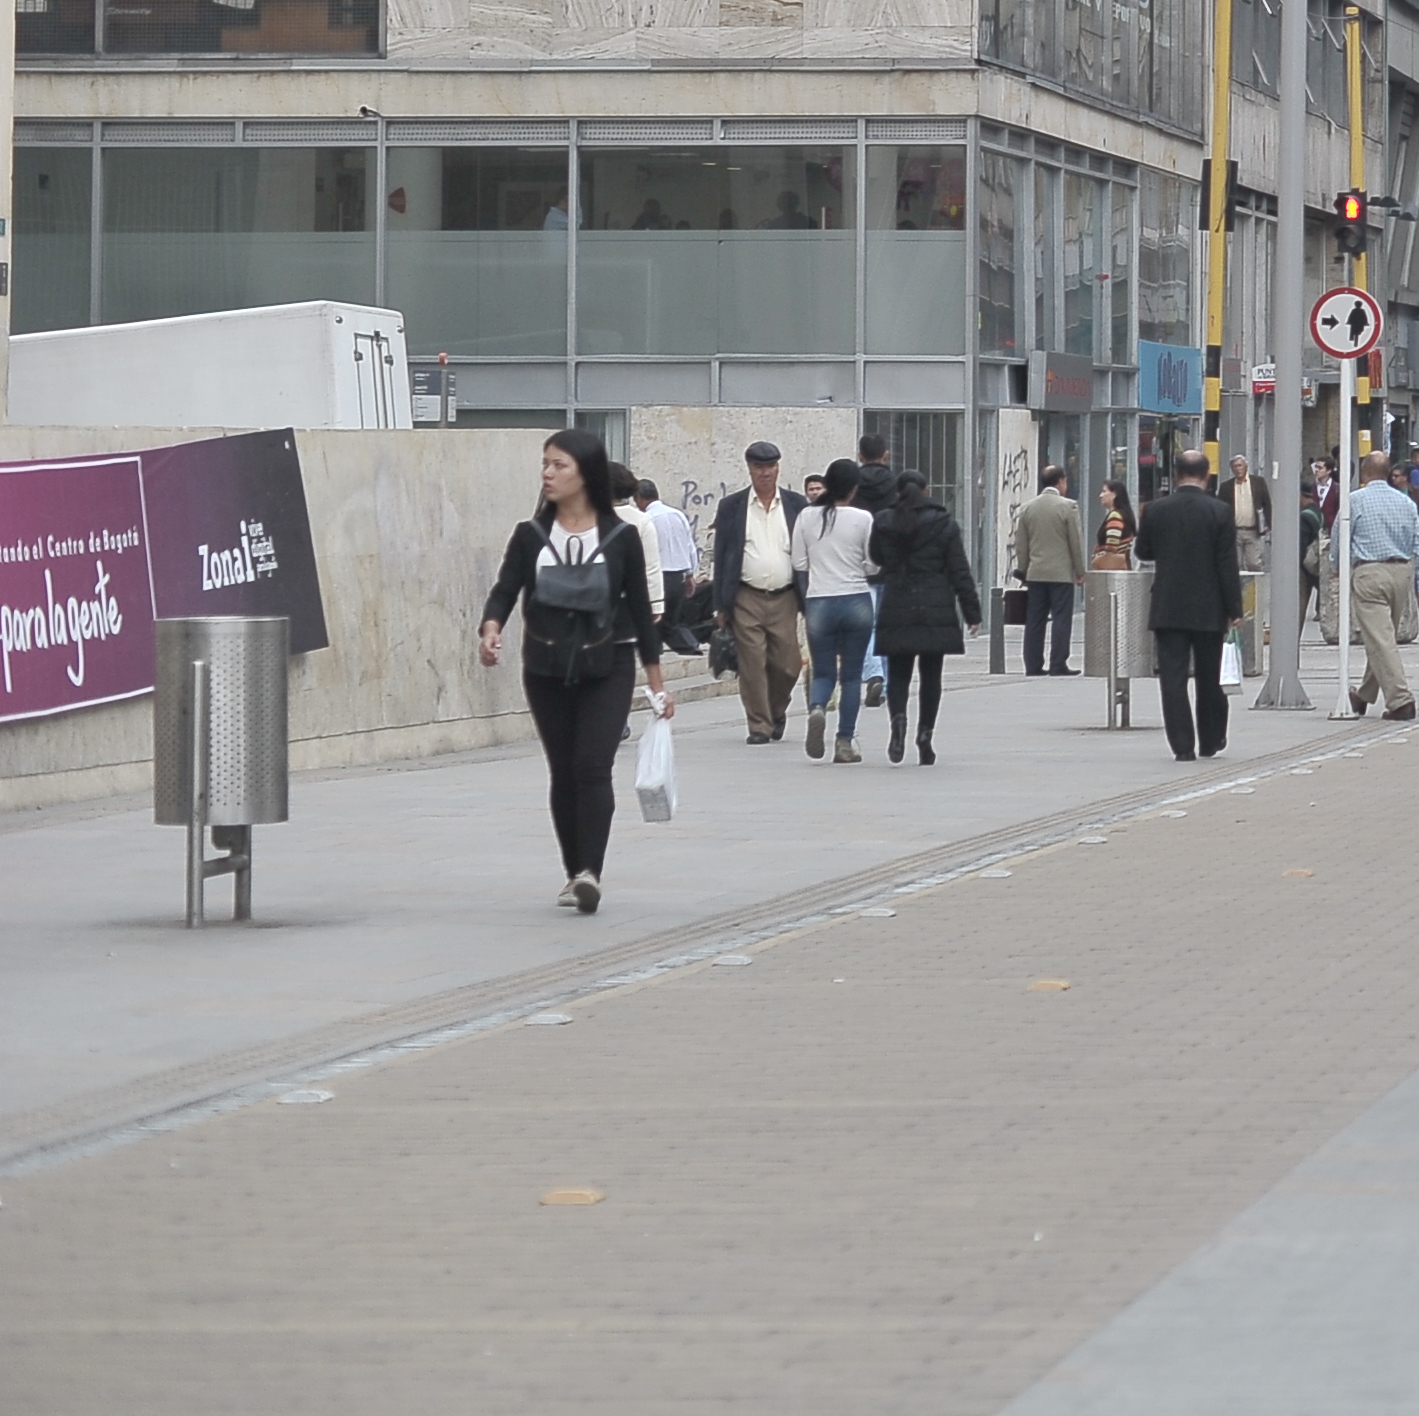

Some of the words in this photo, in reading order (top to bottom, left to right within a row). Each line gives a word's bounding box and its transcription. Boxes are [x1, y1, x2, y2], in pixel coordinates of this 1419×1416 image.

[681, 480, 715, 510] Por
[32, 536, 43, 560] el
[47, 534, 85, 558] Centro
[88, 530, 101, 554] de
[102, 525, 139, 555] Bogotá
[1, 603, 49, 694] para
[44, 567, 69, 646] la
[67, 560, 123, 687] gente
